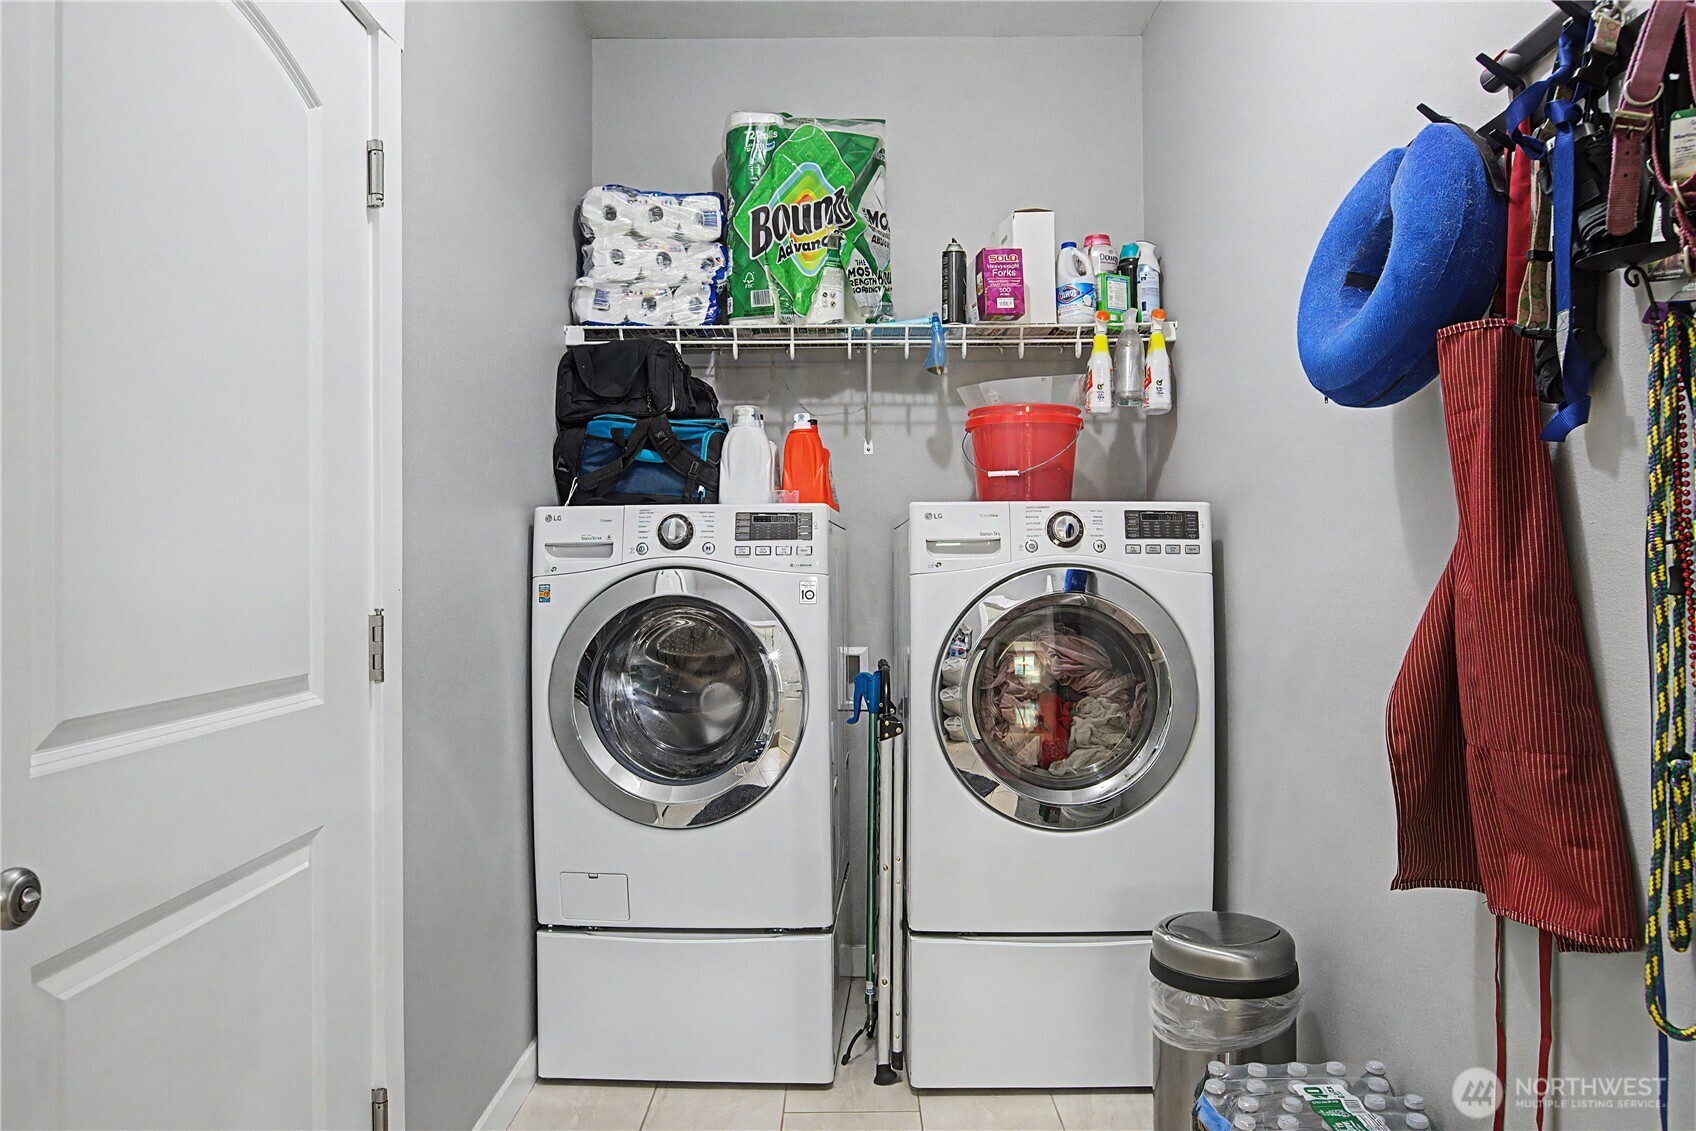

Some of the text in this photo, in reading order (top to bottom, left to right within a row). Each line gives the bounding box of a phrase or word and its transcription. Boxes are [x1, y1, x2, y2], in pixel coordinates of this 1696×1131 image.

[751, 187, 856, 259] Bounty
[777, 229, 844, 263] Advanc
[988, 254, 1019, 262] SOLO
[847, 267, 876, 277] MOS
